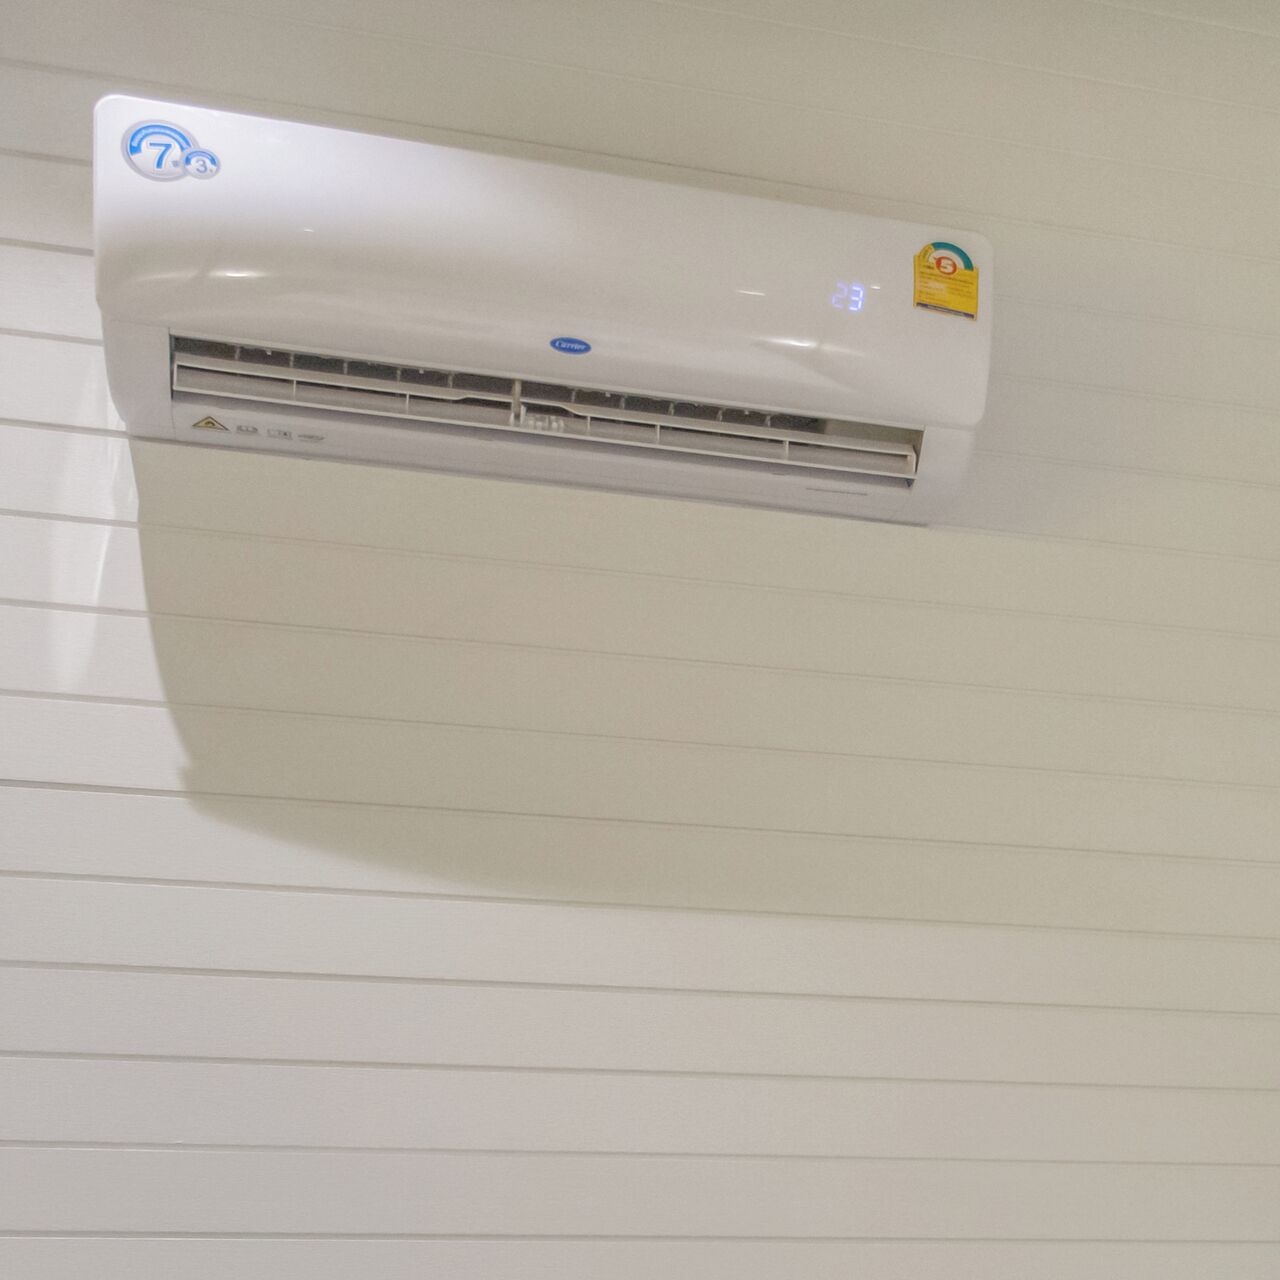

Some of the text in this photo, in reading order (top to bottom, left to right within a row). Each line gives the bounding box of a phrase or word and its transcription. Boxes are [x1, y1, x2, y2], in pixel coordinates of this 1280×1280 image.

[149, 142, 172, 169] 7
[195, 158, 208, 174] 3
[831, 282, 864, 310] 23
[554, 340, 587, 350] Carrier
